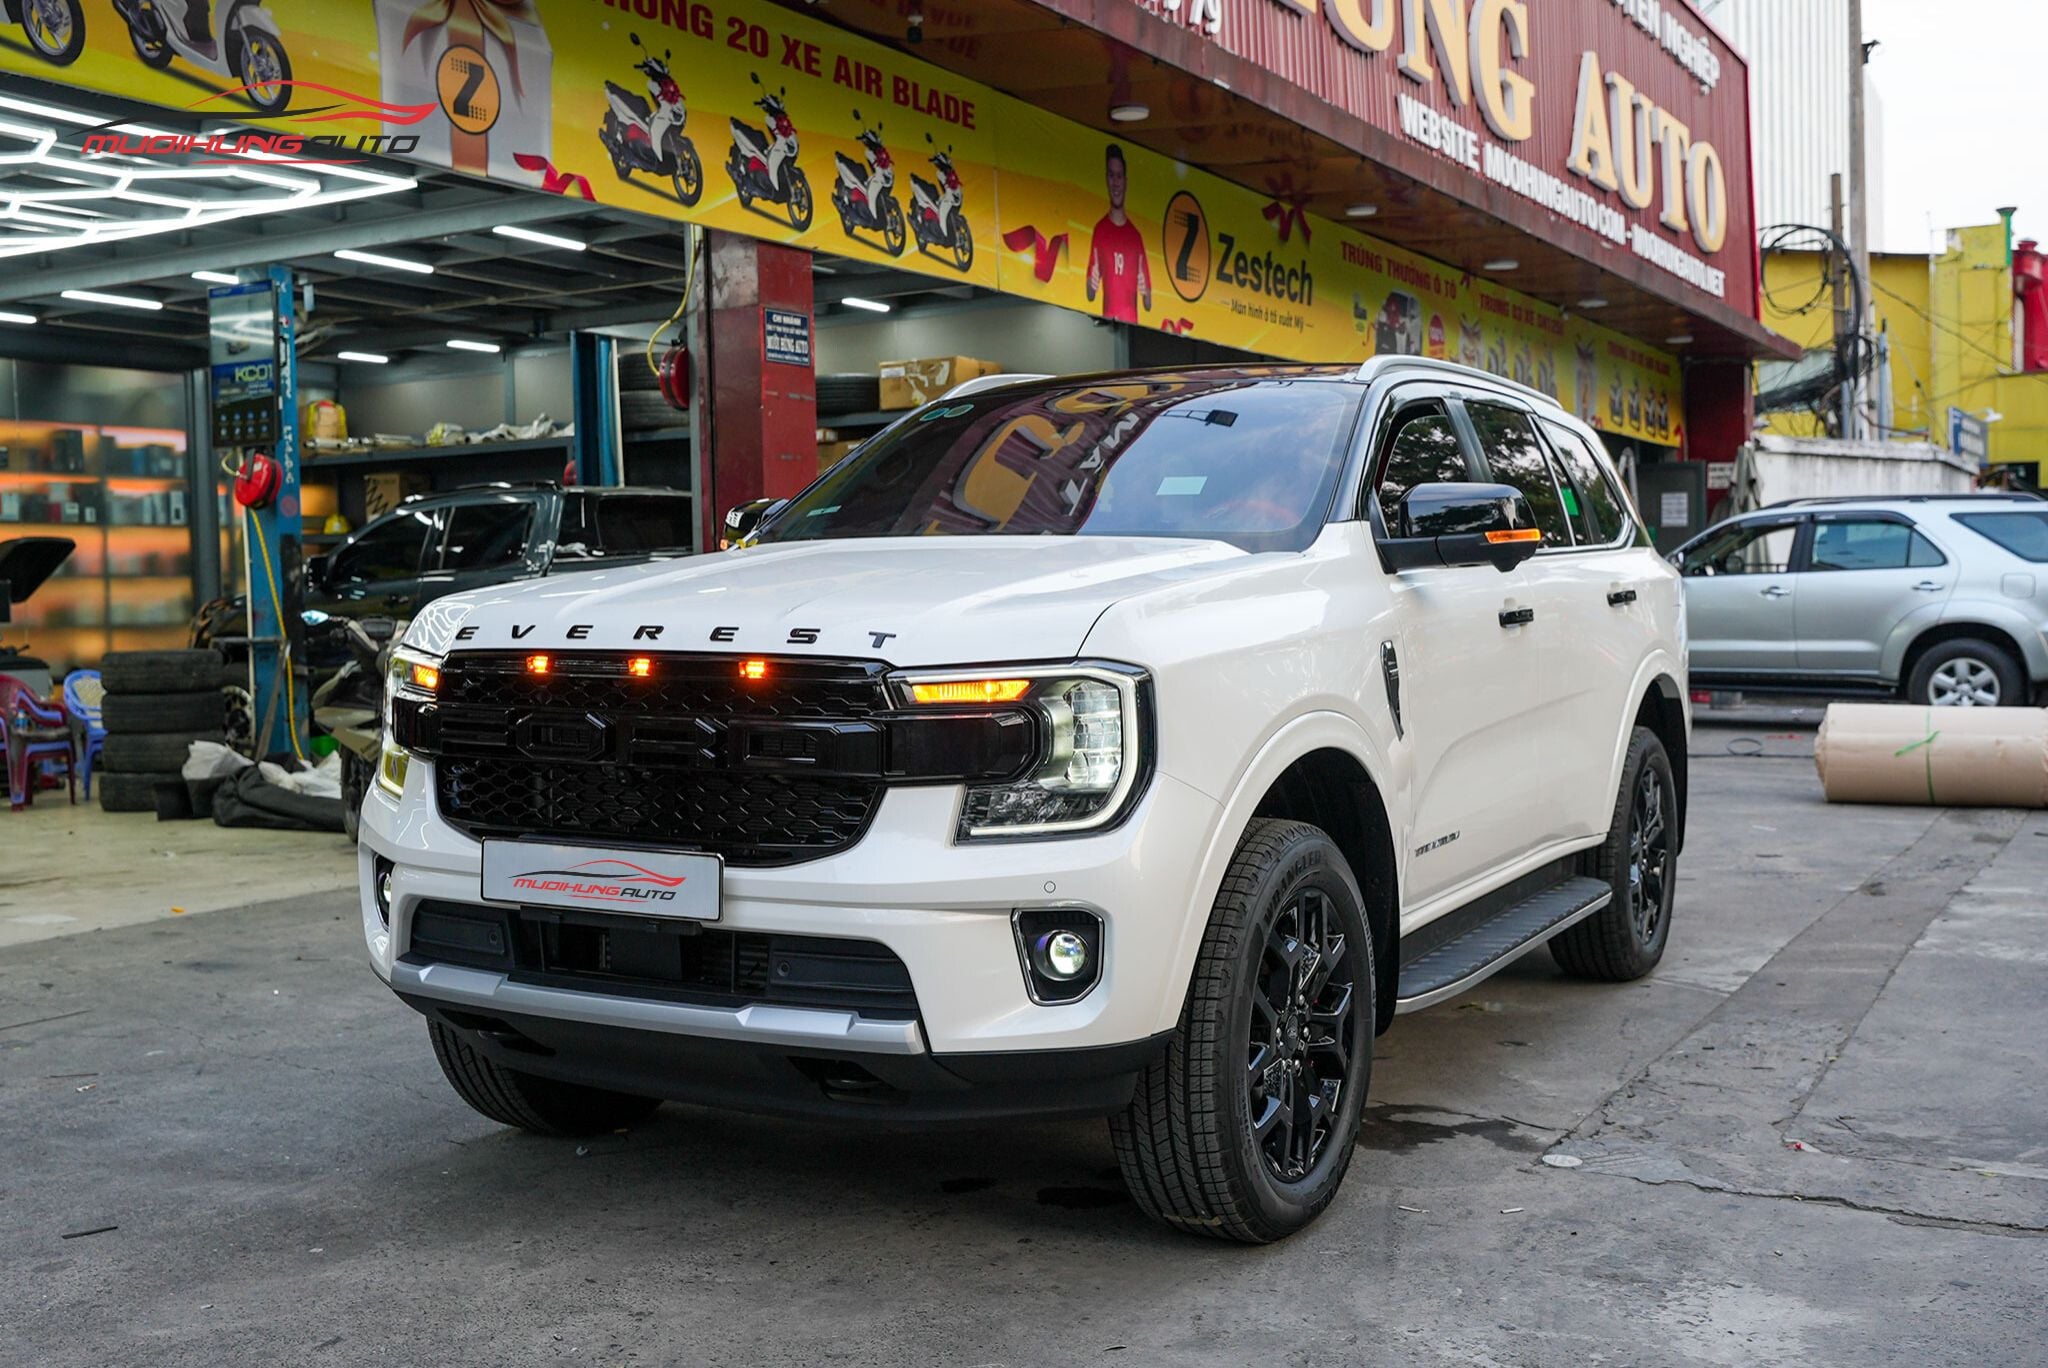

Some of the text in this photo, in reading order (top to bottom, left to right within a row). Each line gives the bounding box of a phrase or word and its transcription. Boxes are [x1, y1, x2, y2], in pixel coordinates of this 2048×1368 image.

[727, 15, 769, 59] 20
[780, 33, 823, 78] XE
[833, 55, 883, 99] AIR
[892, 77, 977, 131] BLADE
[1567, 50, 1727, 254] AUTO
[1113, 252, 1124, 275] 19
[1216, 231, 1313, 306] Zestech
[455, 624, 897, 649] EVEREST
